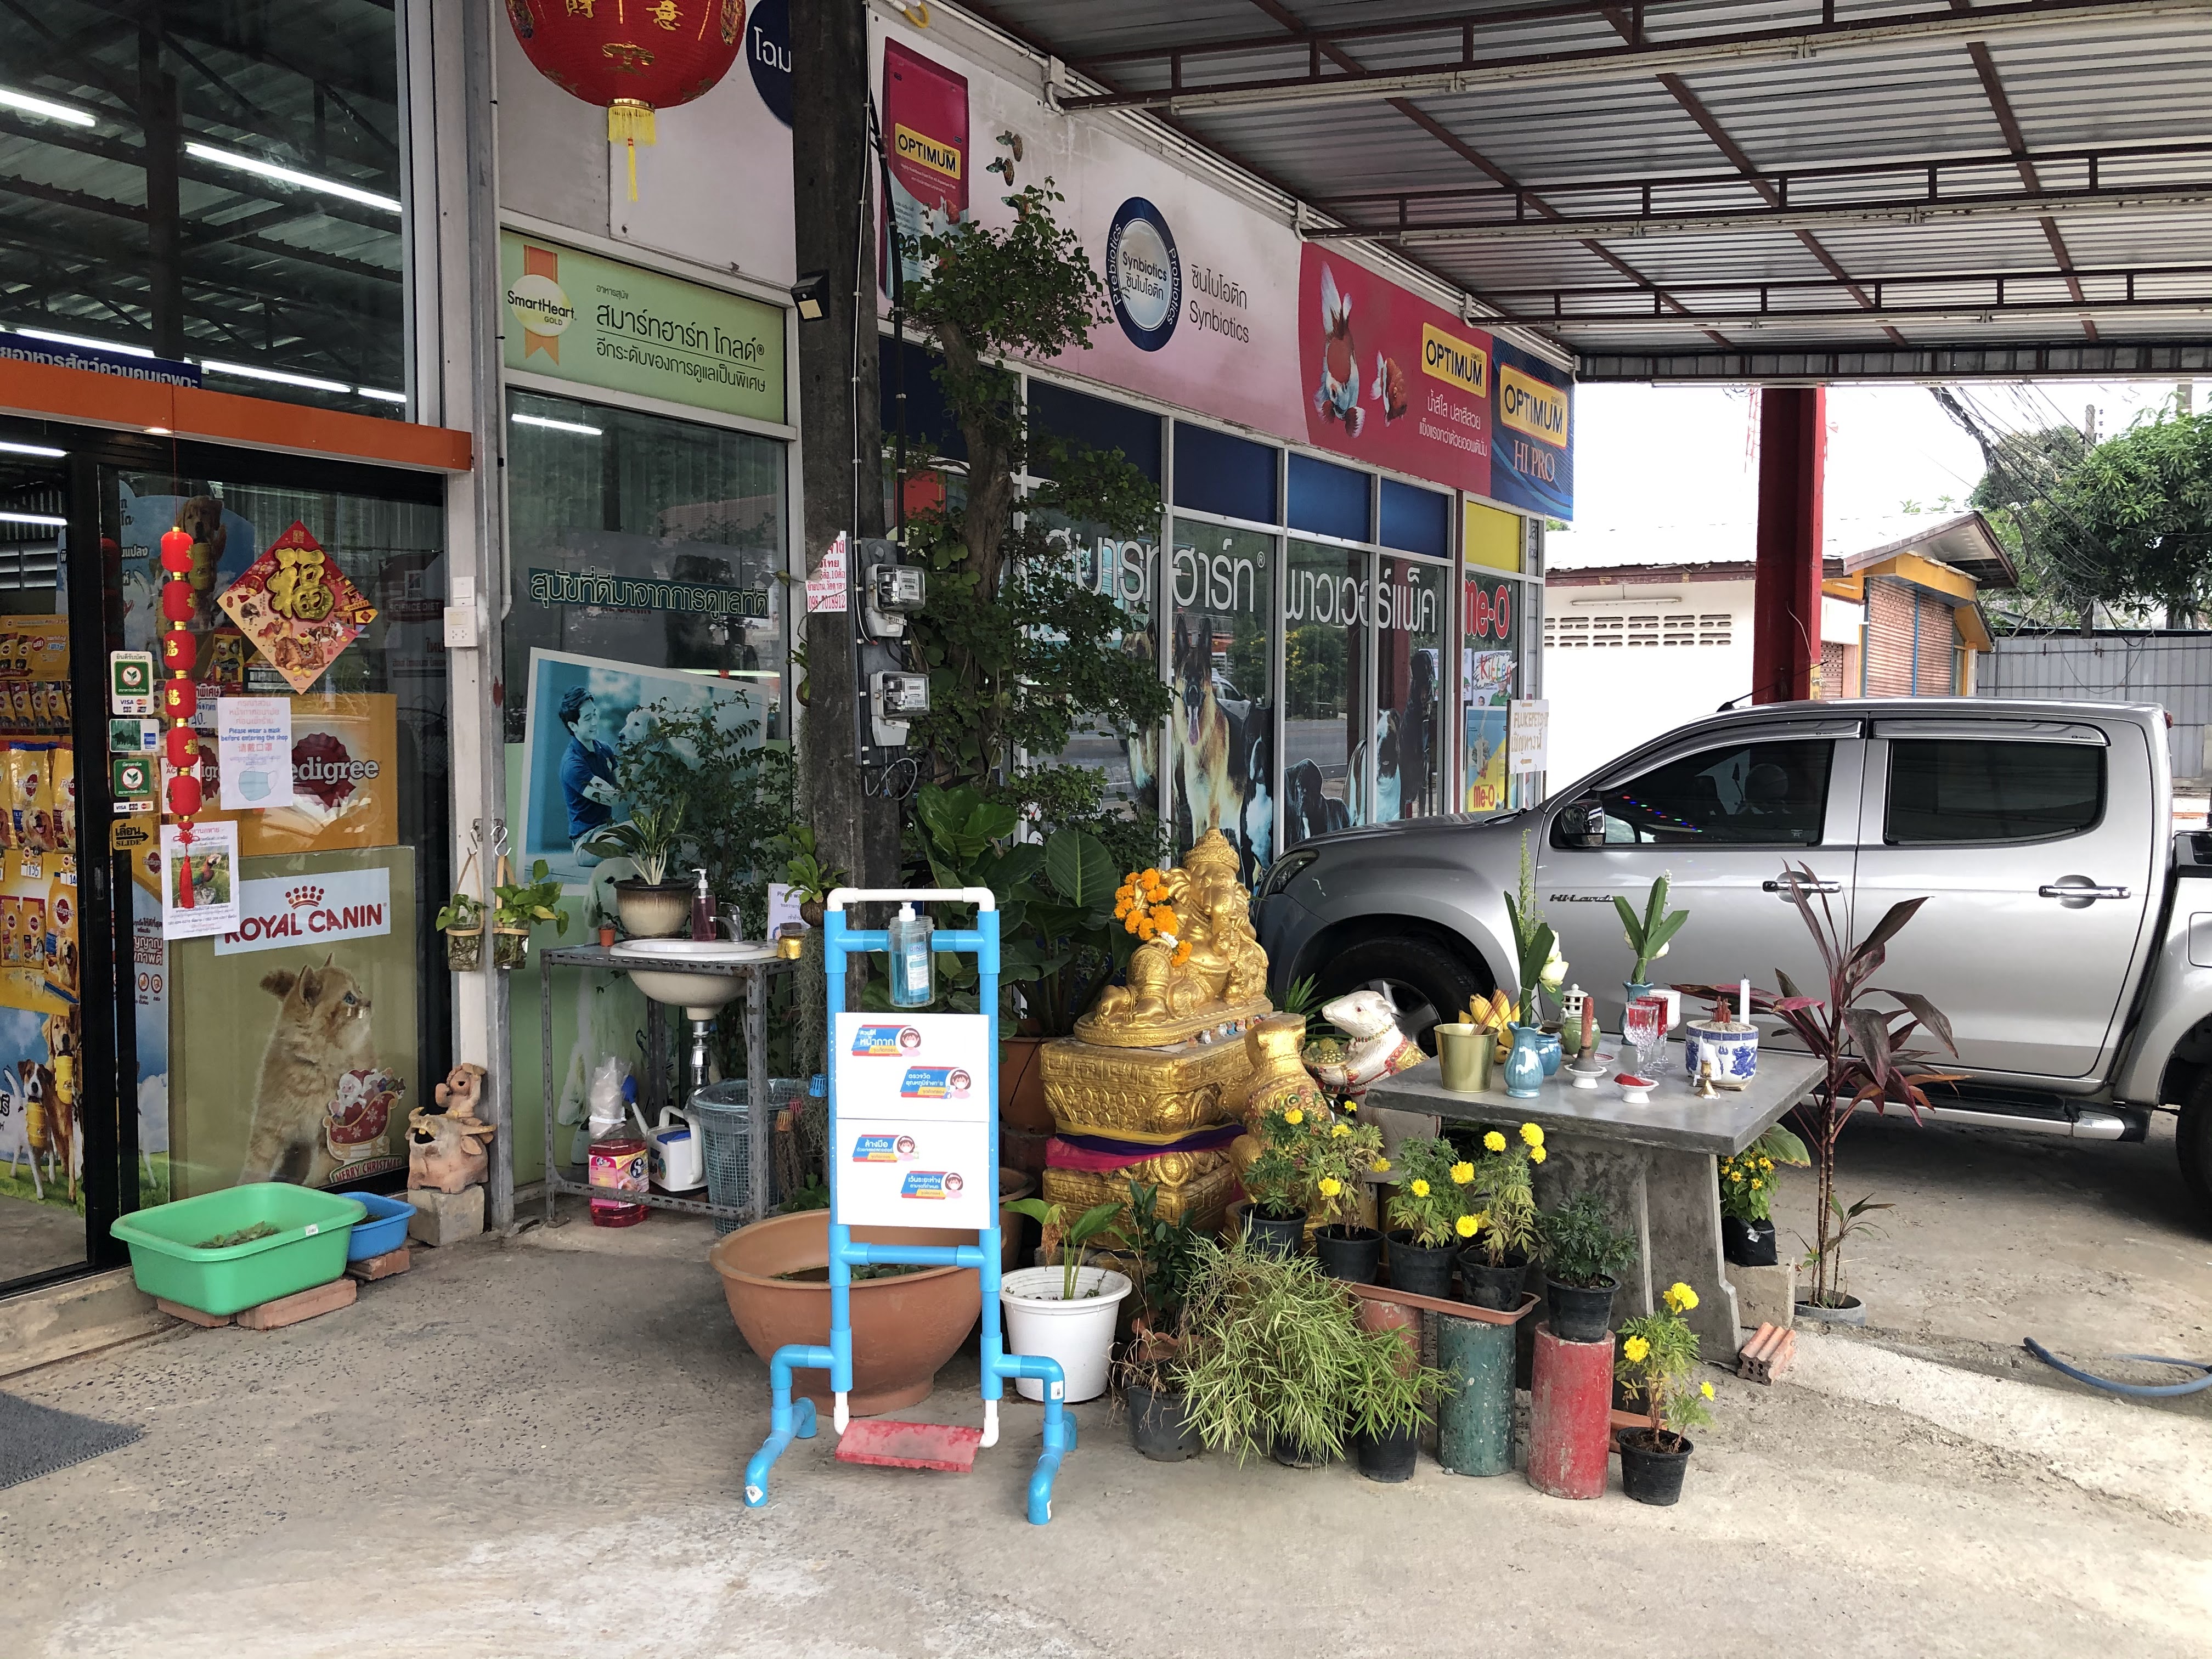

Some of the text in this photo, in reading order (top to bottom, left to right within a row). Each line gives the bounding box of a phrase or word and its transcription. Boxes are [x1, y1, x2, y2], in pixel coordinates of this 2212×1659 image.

[899, 134, 956, 172] OPTIMUM
[1108, 223, 1121, 306] Prebiotics
[1123, 251, 1167, 281] Synbiotics
[596, 284, 629, 300] อาหารสุนัข
[1167, 247, 1180, 325] Probiotics
[507, 290, 575, 319] SmartHeart
[544, 315, 563, 326] GOLD
[597, 304, 708, 351] สมาร์ทฮาร์ท
[1189, 300, 1249, 343] Synbiotics
[597, 338, 766, 393] อีกระดับของการดูแลเป็นพิเศษ
[1426, 340, 1482, 387] OPTIMUM
[1504, 384, 1563, 435] OPTIMUM
[1514, 439, 1555, 482] HI PRO
[267, 548, 334, 621] 福
[531, 566, 769, 620] สุนัขที่ดีมาจากการดูแลที่ดี
[390, 602, 440, 612] SCIENCE DIET
[291, 757, 380, 784] edigree
[115, 823, 140, 837] เลื่อน
[116, 839, 142, 847] SLIDE
[29, 865, 39, 877] 135
[308, 903, 382, 933] CANIN
[860, 1036, 894, 1046] หน้ากาก
[865, 1139, 888, 1148] ล้างมือ
[335, 1164, 360, 1182] MERRY
[908, 1175, 941, 1183] เว้นระยะห่าง
